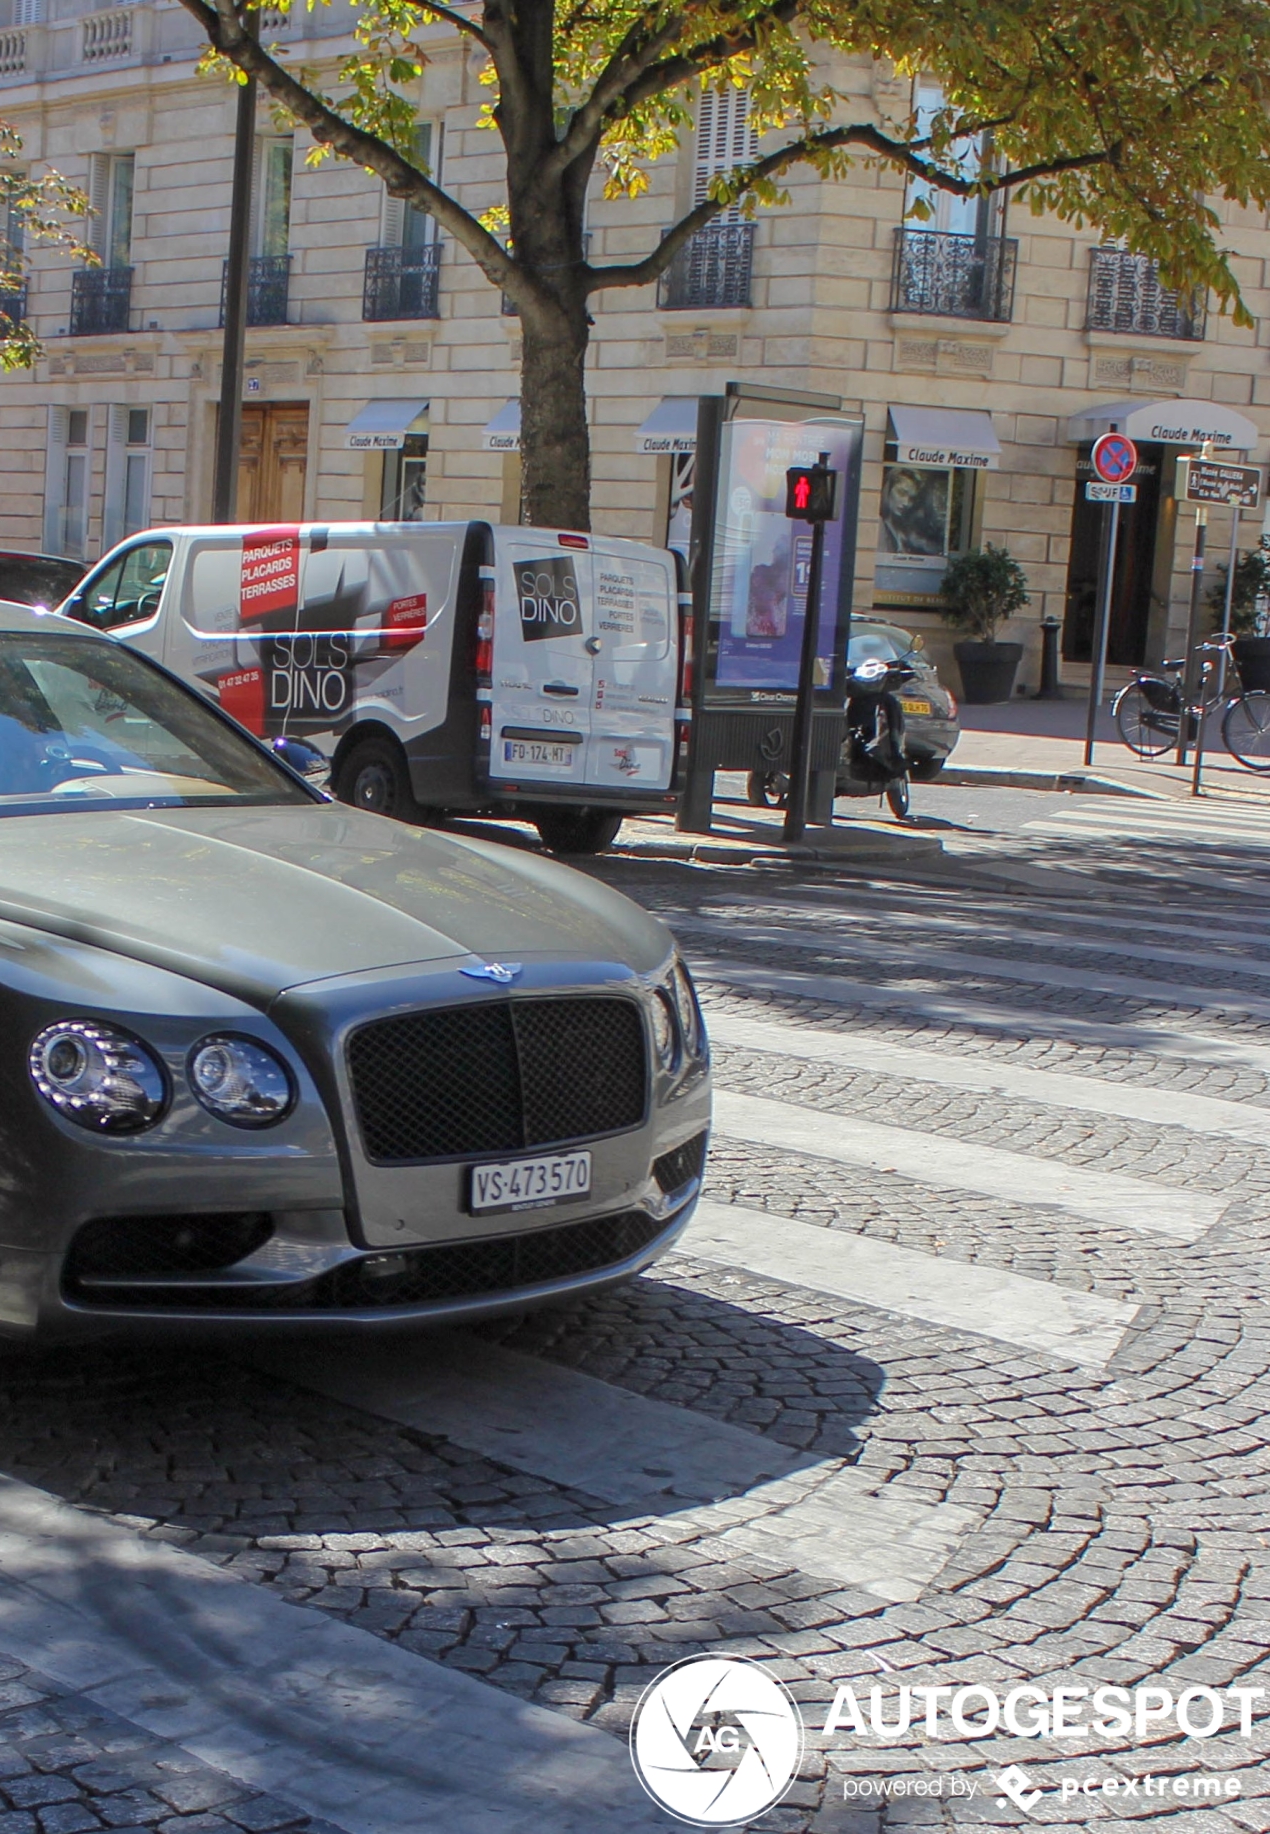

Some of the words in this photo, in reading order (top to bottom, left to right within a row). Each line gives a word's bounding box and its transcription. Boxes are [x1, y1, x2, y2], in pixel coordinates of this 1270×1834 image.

[350, 436, 371, 446] Claude
[373, 436, 398, 446] Maxime
[490, 436, 514, 447] Claude
[1151, 425, 1187, 440] Claude
[1190, 429, 1232, 444] Maxime
[644, 439, 670, 450] Claude
[908, 448, 945, 463] Claude
[948, 452, 989, 467] Maxime
[242, 538, 293, 564] PARQUETS
[242, 556, 293, 582] PLACARDS
[521, 571, 576, 601] SOLS
[600, 573, 634, 585] PARQUETS
[241, 574, 296, 600] TERRASSES
[600, 585, 634, 597] PLACARDS
[393, 597, 417, 611] PORTES
[597, 596, 634, 609] TERRASSES
[521, 596, 577, 625] DINO
[609, 610, 634, 621] PORTES
[272, 632, 348, 669] SOLS
[227, 677, 234, 686] 47
[243, 673, 250, 682] 47
[271, 670, 346, 711] DINO
[543, 709, 574, 724] DINO
